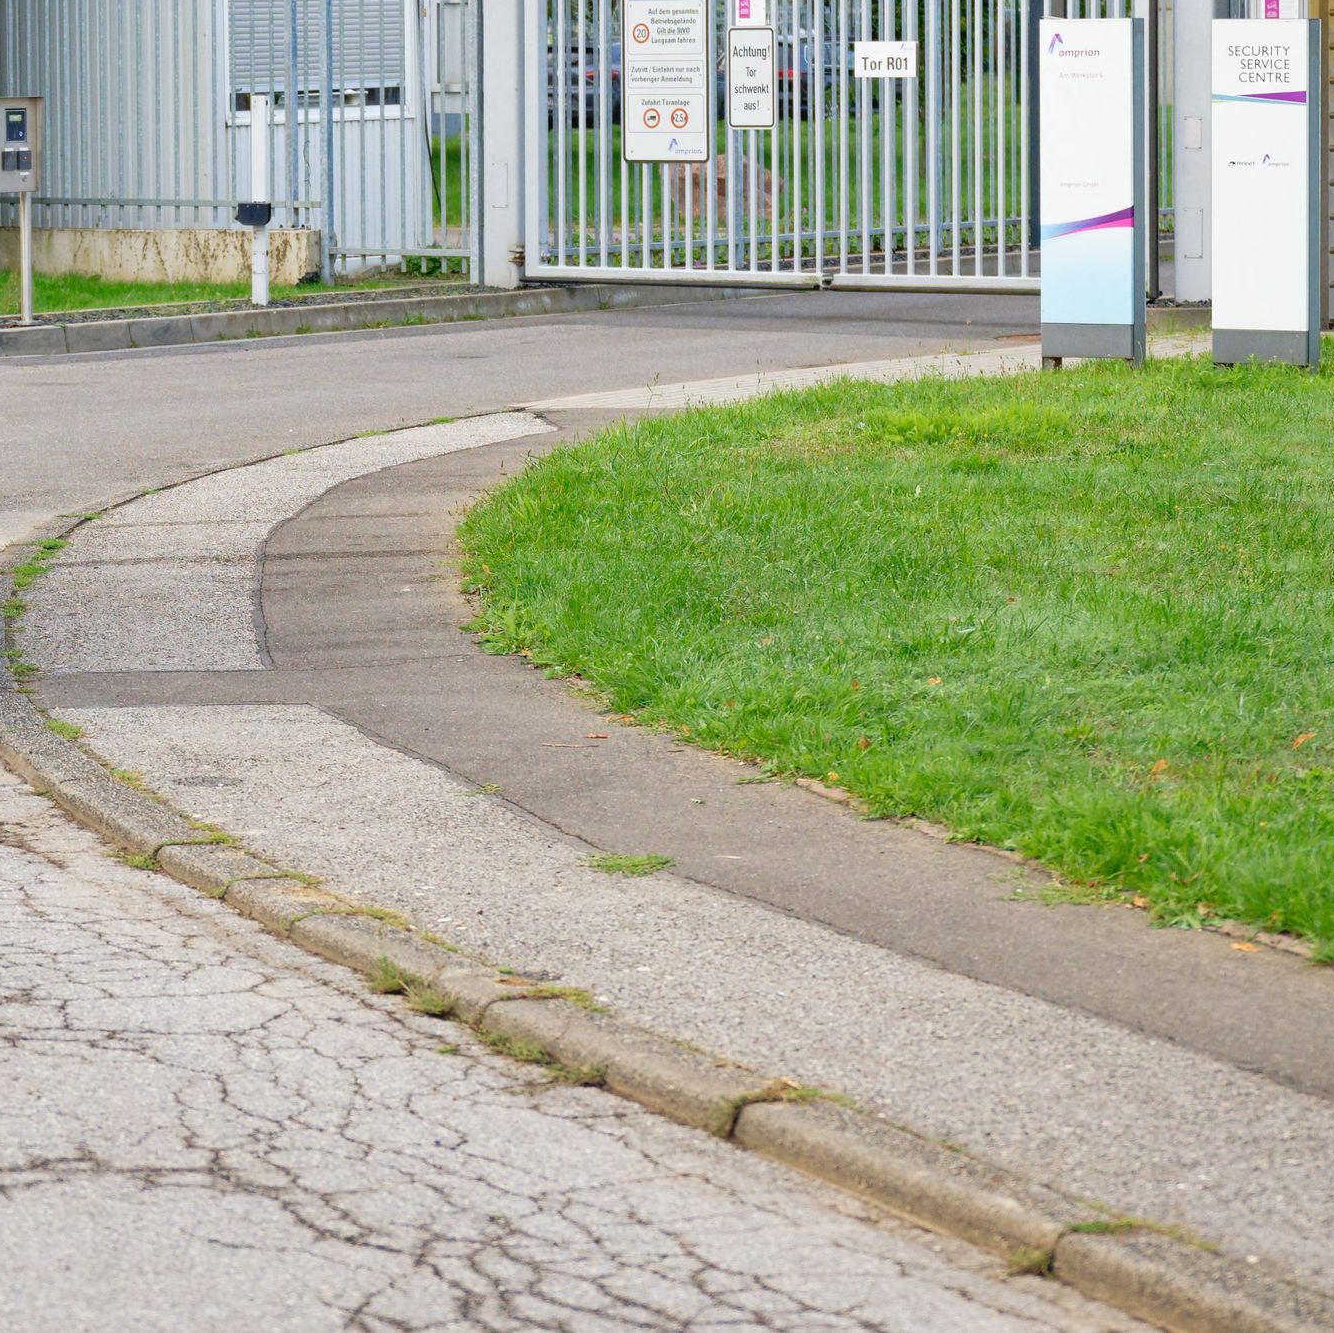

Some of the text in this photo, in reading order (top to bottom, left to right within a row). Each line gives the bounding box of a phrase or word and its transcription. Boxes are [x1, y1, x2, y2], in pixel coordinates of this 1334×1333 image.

[672, 8, 699, 16] gesamten
[636, 28, 647, 39] 20
[656, 27, 667, 35] Gilt
[667, 27, 676, 35] die
[651, 37, 677, 45] Langsam
[732, 45, 771, 60] Achtung!
[1058, 49, 1100, 58] amprion
[1227, 45, 1291, 57] SECURITY
[861, 56, 908, 71] Tor R01
[1240, 58, 1291, 70] SERVICE
[745, 66, 757, 77] Tor
[631, 75, 693, 84] vorheriger Anmeldung
[1238, 72, 1291, 83] CENTRE
[734, 84, 770, 94] schwenkt
[641, 98, 691, 107] Zufahrt Toranlage
[743, 100, 760, 111] aus!
